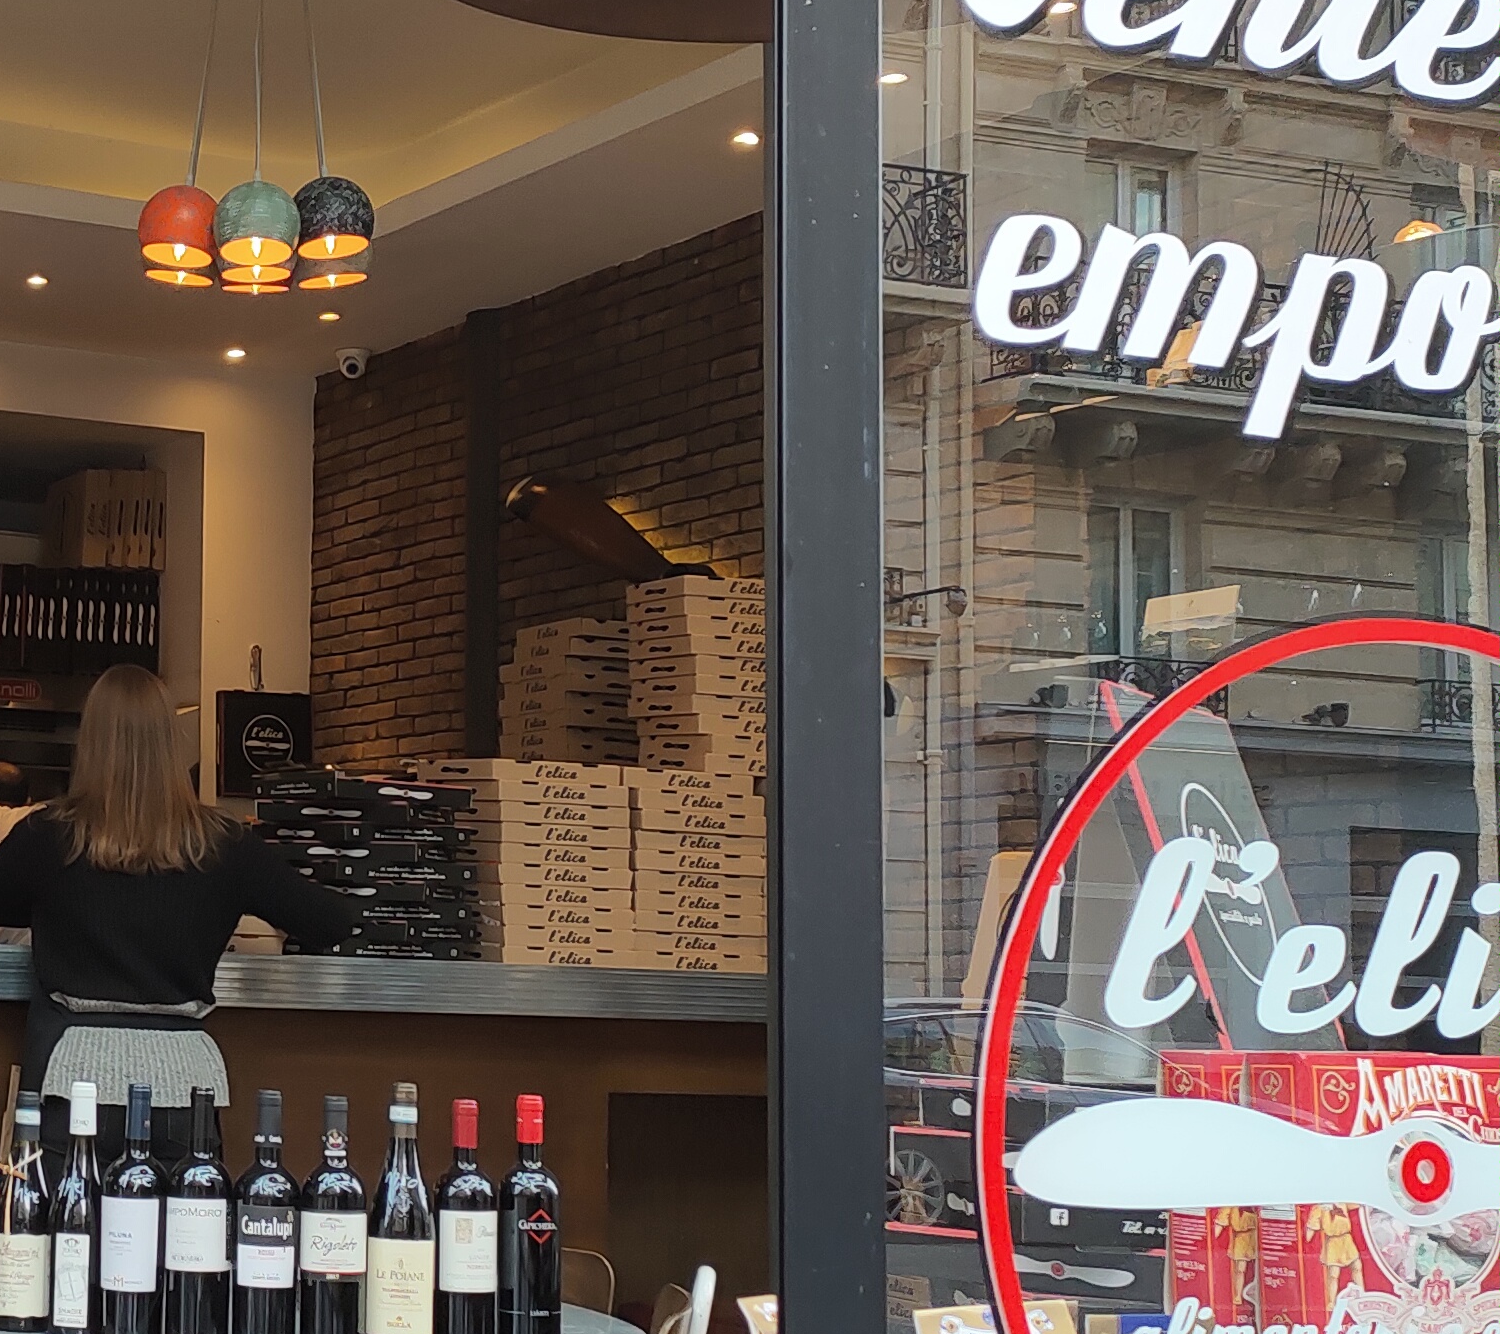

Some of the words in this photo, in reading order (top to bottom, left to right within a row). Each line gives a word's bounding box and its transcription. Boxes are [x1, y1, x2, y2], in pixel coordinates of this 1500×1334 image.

[973, 213, 1500, 439] empo
[535, 765, 577, 780] l'elica
[668, 774, 711, 789] l'elica
[542, 785, 586, 800] l'elica
[681, 794, 723, 809] l'elica
[544, 807, 586, 821] l'elica
[685, 815, 726, 829] l'elica
[545, 828, 588, 842] l'elica
[680, 835, 721, 849] l'elica
[544, 849, 586, 863] l'elica
[679, 855, 720, 869] l'elica
[544, 868, 586, 883] l'elica
[678, 875, 719, 889] l'elica
[545, 889, 588, 904] l'elica
[678, 895, 720, 909] l'elica
[548, 910, 590, 924] l'elica
[677, 915, 719, 929] l'elica
[549, 930, 591, 944] l'elica
[675, 936, 716, 950] l'elica
[548, 951, 592, 965] l'elica
[676, 956, 718, 970] l'elica
[1350, 1057, 1486, 1137] AMARETTI
[241, 1214, 294, 1241] Cantalupi
[375, 1268, 387, 1280] LE
